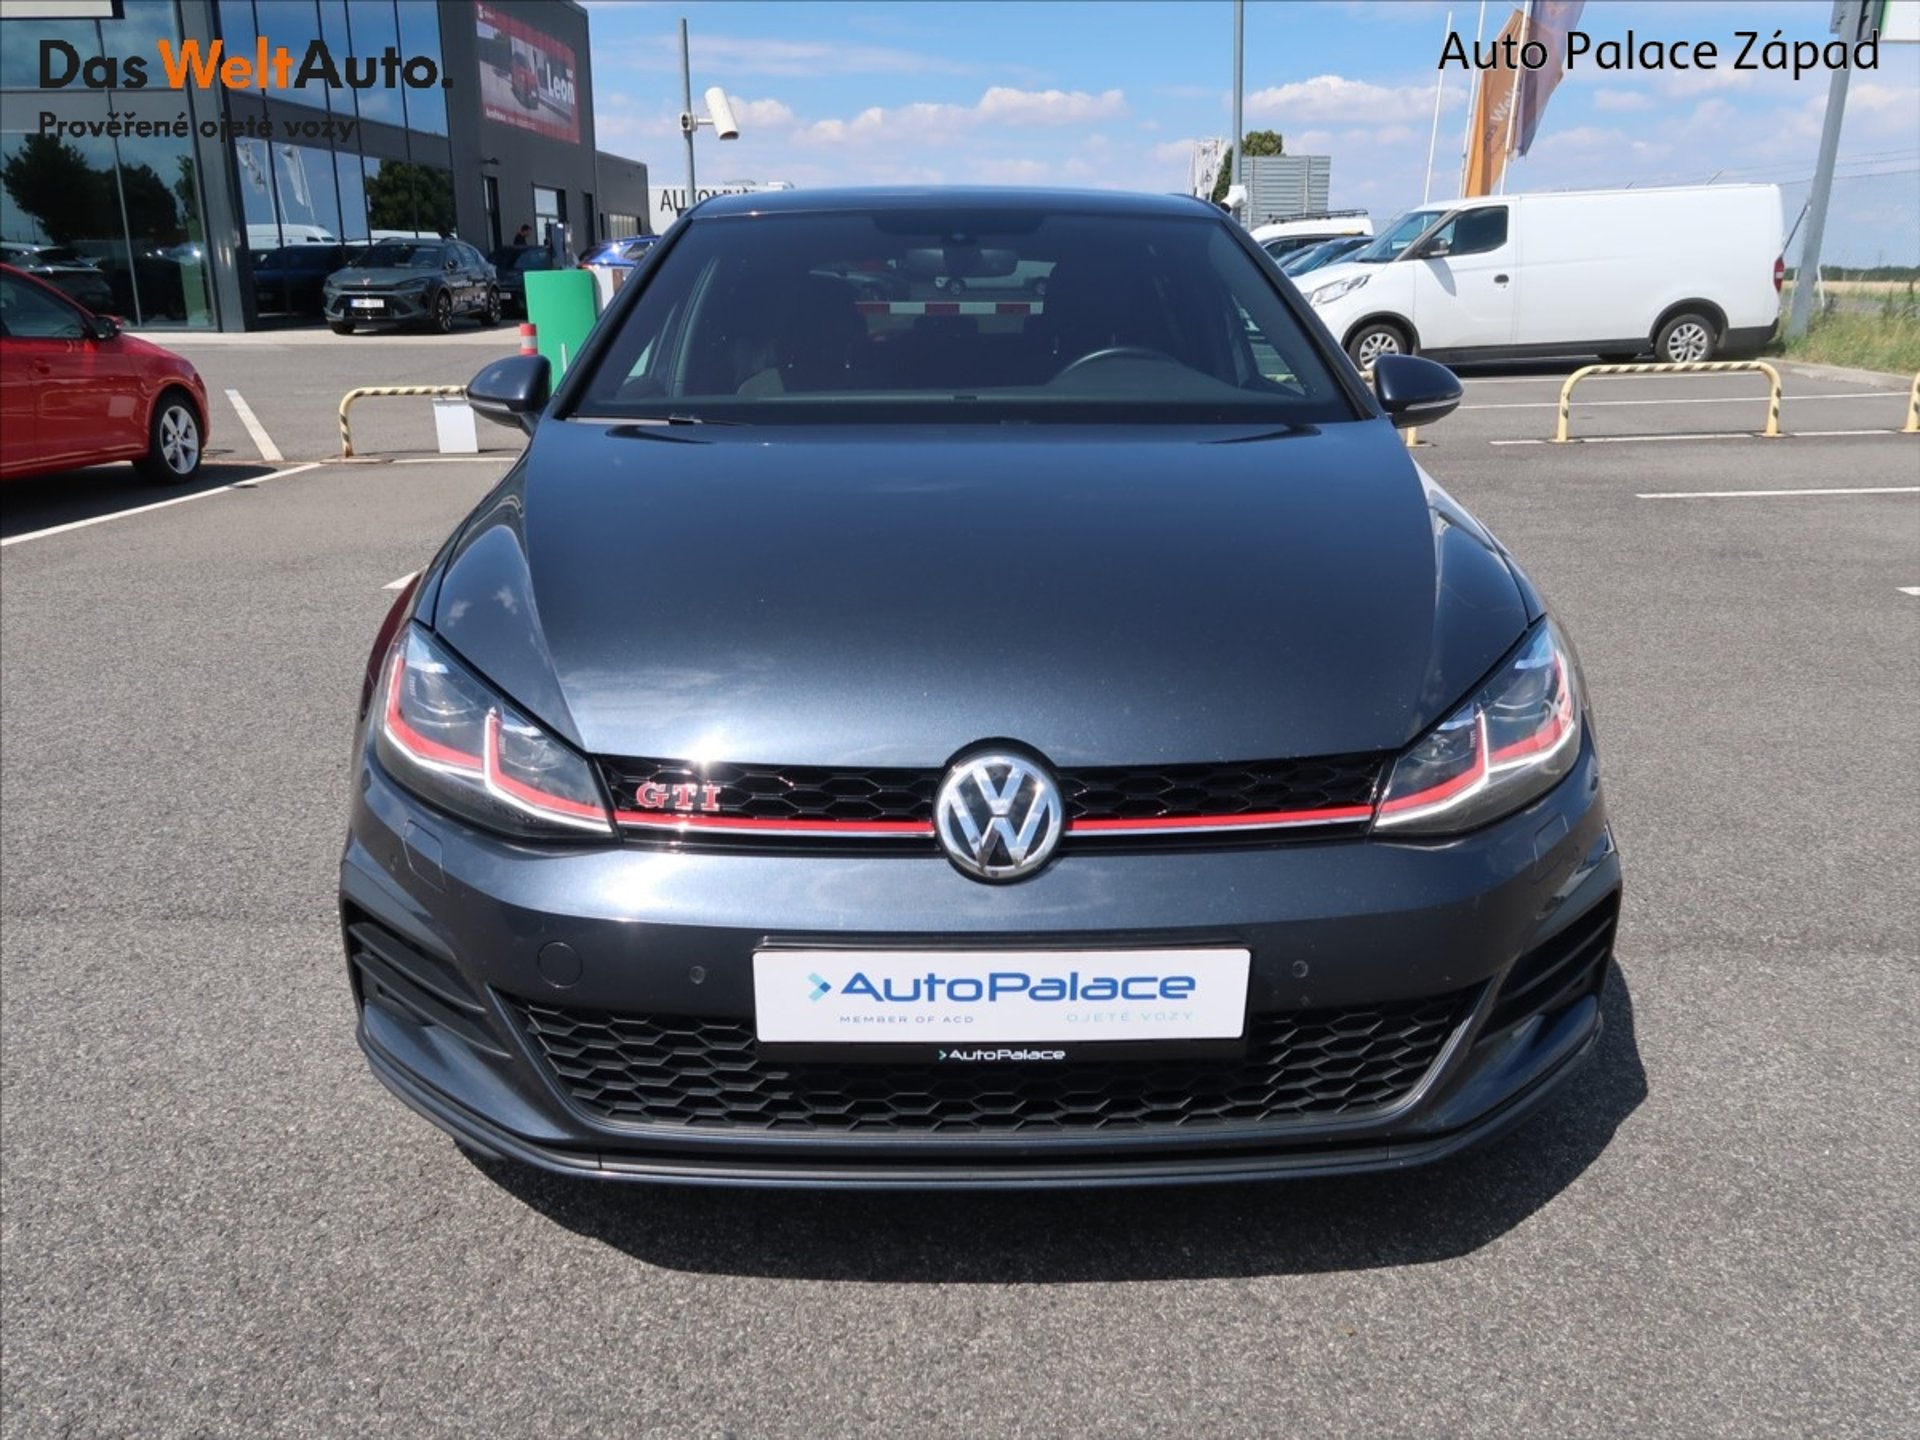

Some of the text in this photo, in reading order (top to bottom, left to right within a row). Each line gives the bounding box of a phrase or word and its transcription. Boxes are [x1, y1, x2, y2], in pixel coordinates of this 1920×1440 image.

[636, 781, 721, 811] GTI
[841, 972, 1196, 1002] AutoPalace
[839, 1015, 974, 1024] MEMBER OF ACD
[1066, 1011, 1193, 1023] OJETÉ VOZY
[949, 1049, 1066, 1061] AutoPalace
